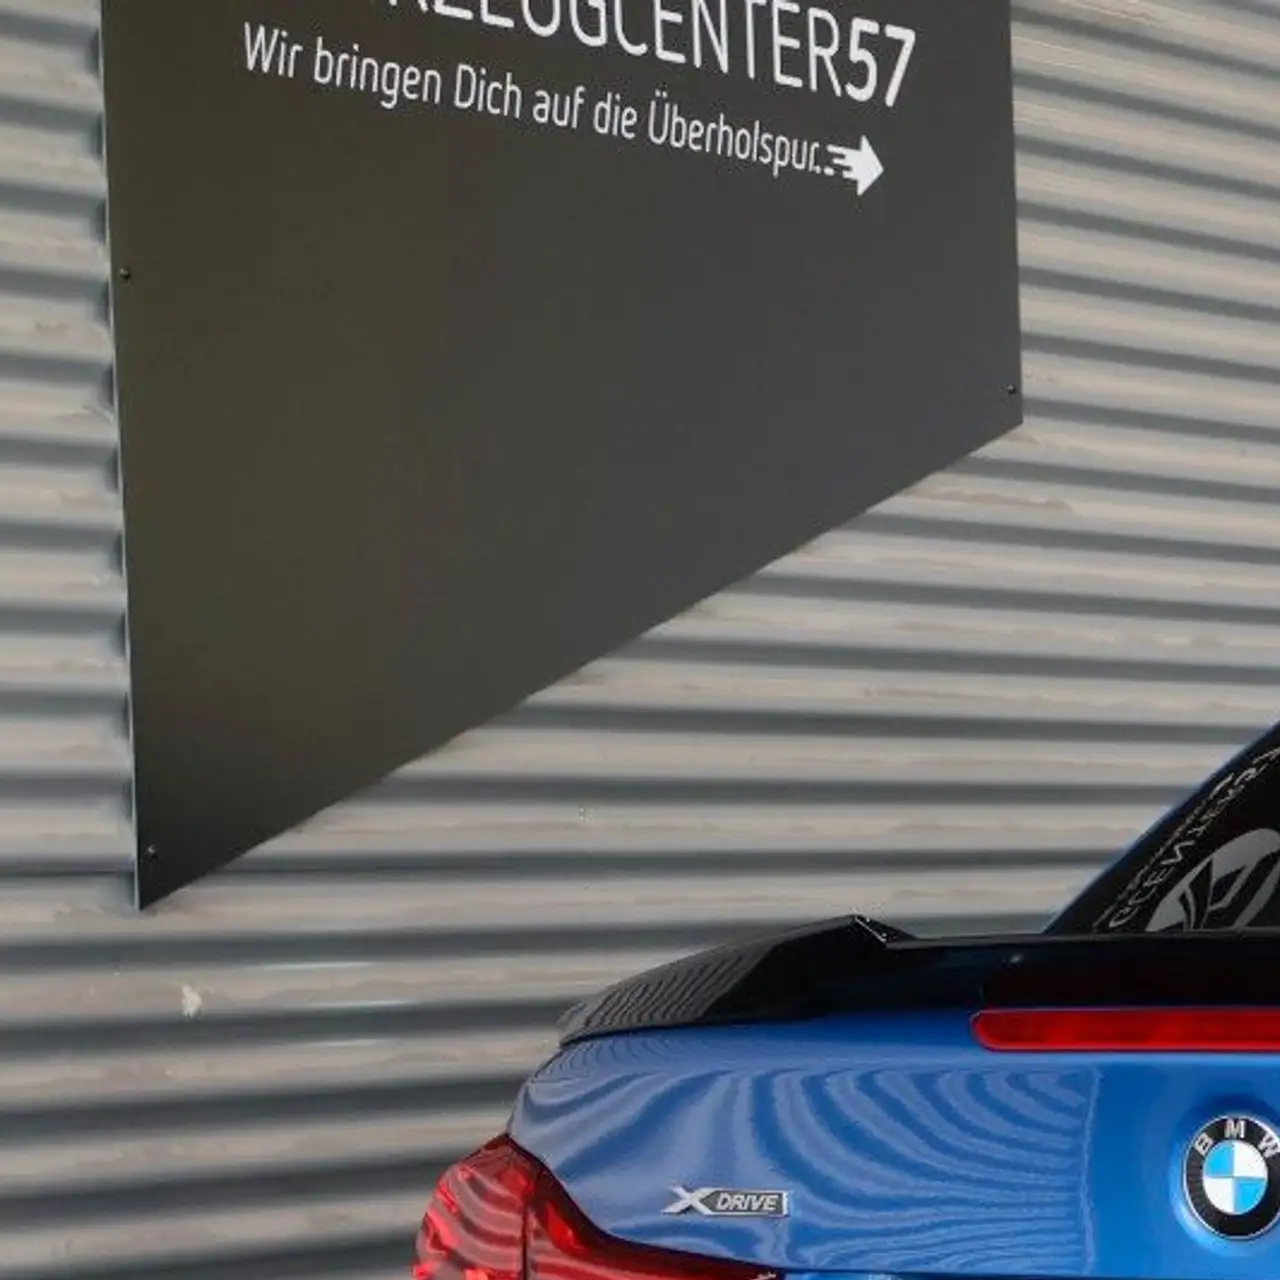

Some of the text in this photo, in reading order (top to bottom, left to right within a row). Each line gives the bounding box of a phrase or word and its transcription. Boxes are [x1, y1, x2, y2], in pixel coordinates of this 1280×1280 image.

[244, 21, 303, 78] Wir
[313, 36, 442, 109] bringen
[453, 63, 522, 118] Dich
[532, 85, 586, 129] auf
[593, 91, 638, 140] die
